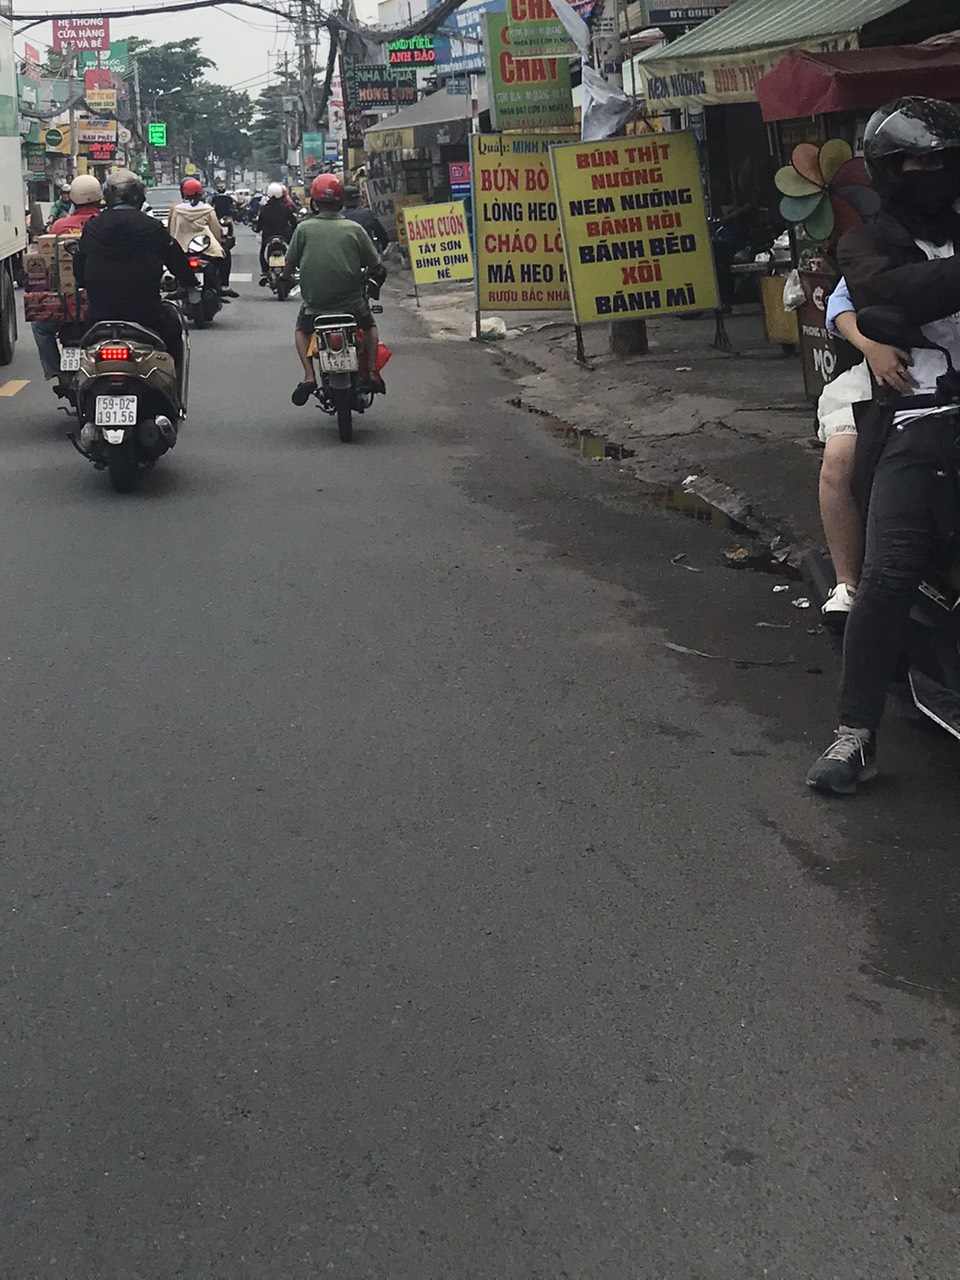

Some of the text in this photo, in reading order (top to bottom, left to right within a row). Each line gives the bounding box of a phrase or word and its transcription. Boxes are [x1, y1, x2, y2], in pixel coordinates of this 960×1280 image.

[57, 27, 105, 39] CỬA HÀNG
[76, 38, 89, 48] VÀ
[390, 51, 412, 63] ANH
[512, 140, 538, 153] MINH
[576, 142, 671, 169] BÚN THỊT
[481, 162, 550, 192] BÚN BÒ
[591, 167, 663, 190] NƯỚNG
[483, 198, 557, 222] LÒNG HEO
[569, 188, 693, 217] NEM NƯỚNG
[408, 206, 465, 241] BÁNH CUỐN
[586, 216, 643, 237] BÁNH
[418, 240, 462, 254] TÂY SƠN
[485, 228, 537, 254] CHÁO
[579, 232, 697, 264] BÁNH BÈO
[416, 253, 469, 268] BÌNH ĐỊNH
[488, 260, 515, 283] MÁ
[521, 264, 553, 283] HEO
[621, 259, 663, 285] XÔI
[488, 289, 517, 302] RƯỢU
[595, 283, 696, 315] BÁNH MÌ
